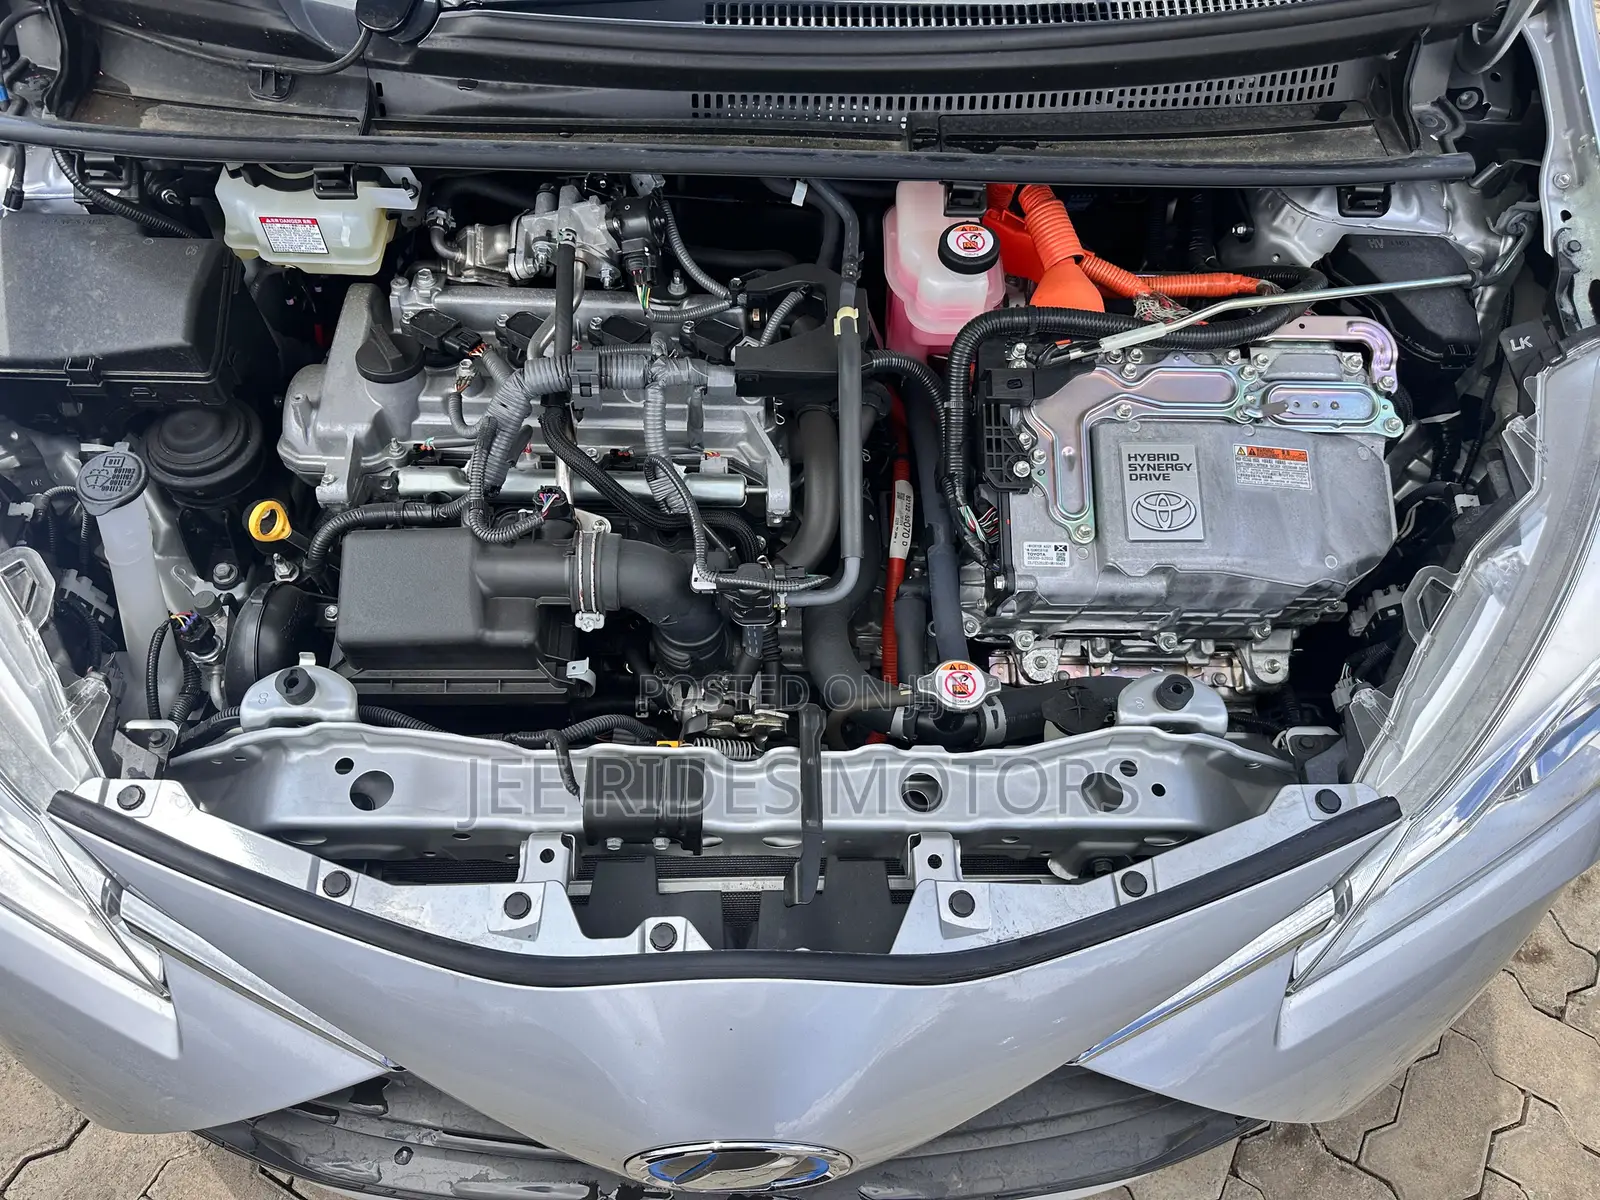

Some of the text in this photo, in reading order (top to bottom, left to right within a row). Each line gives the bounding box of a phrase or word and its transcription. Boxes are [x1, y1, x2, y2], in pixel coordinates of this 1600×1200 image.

[1509, 335, 1534, 352] LK
[1127, 452, 1180, 462] HYBRID
[1128, 462, 1193, 472] SYNERGY
[1129, 472, 1171, 482] DRIVE
